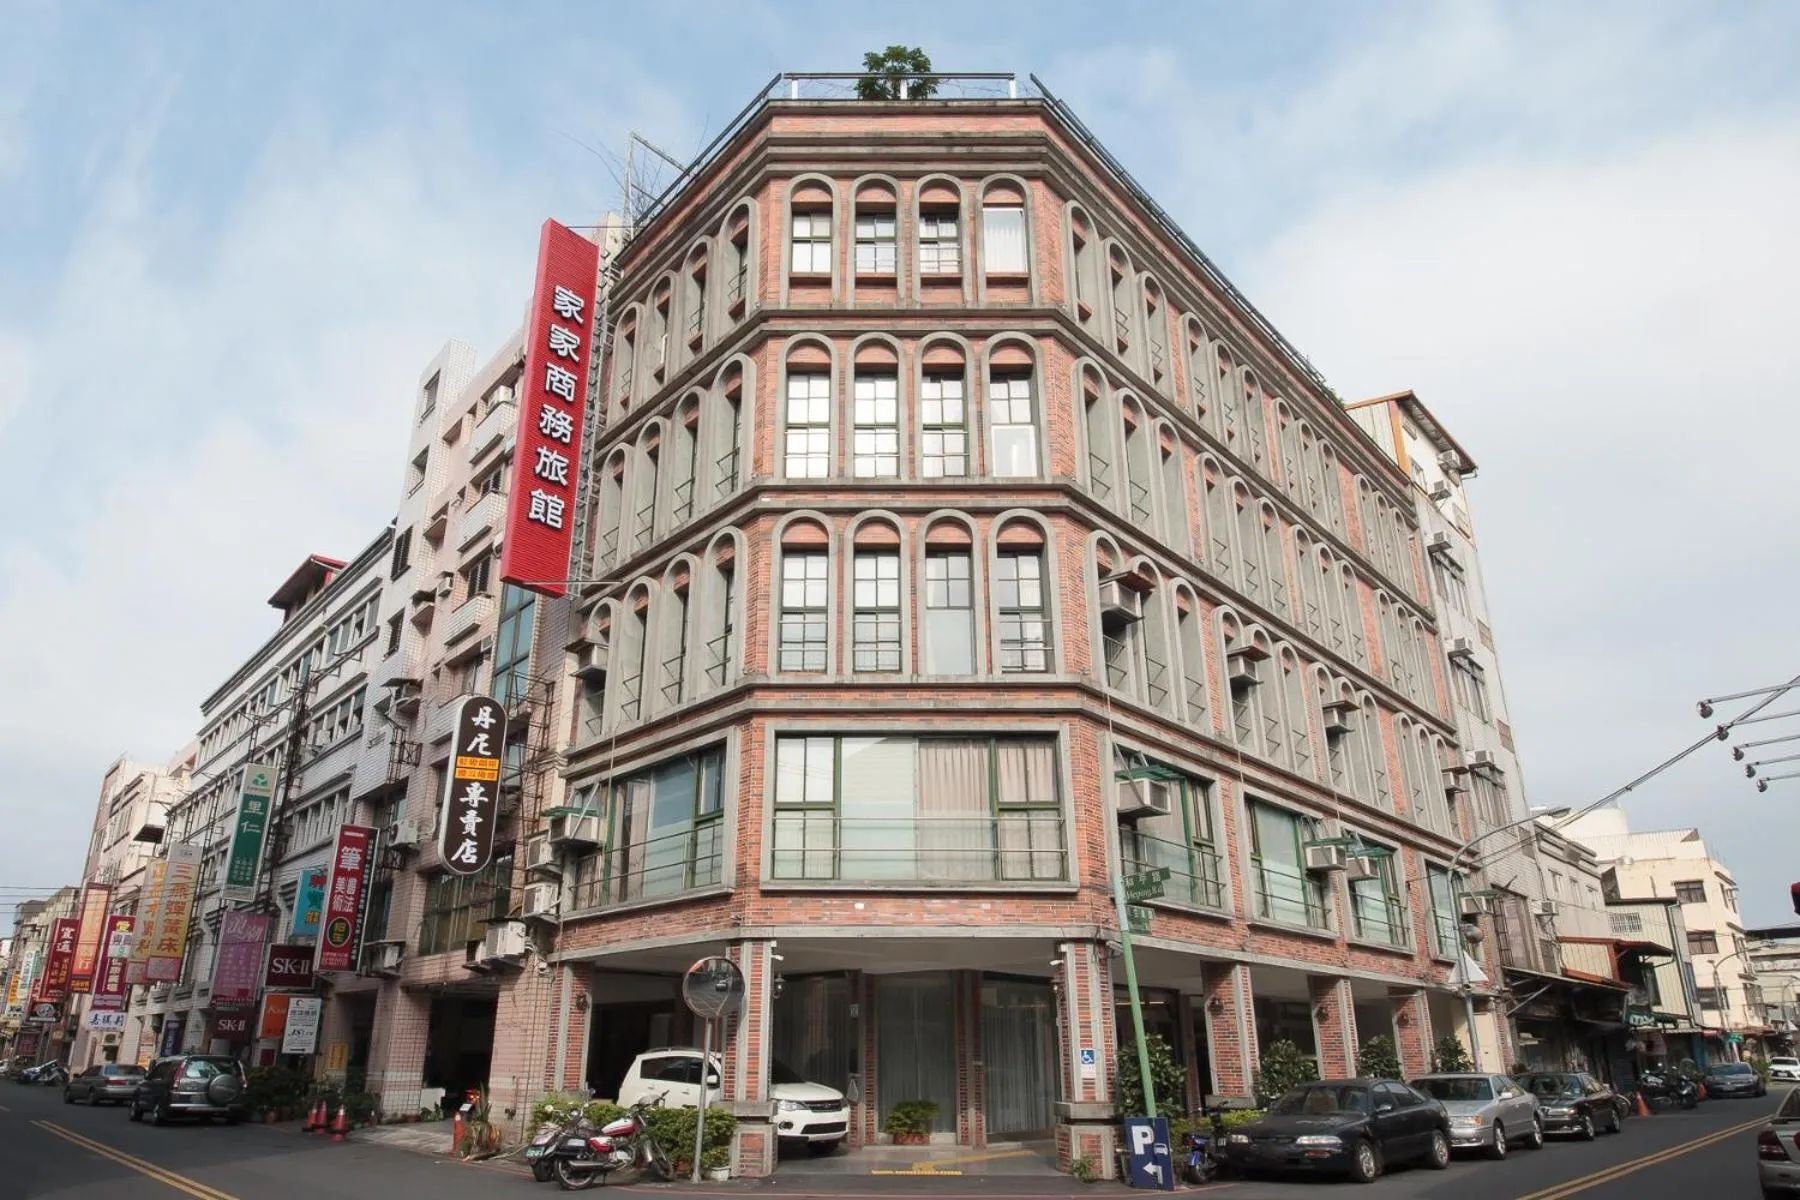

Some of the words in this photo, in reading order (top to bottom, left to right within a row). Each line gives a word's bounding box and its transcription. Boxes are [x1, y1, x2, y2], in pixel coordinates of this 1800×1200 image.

[529, 285, 585, 529] 家家商務旅館
[467, 706, 496, 756] 丹尼
[241, 801, 265, 834] 里仁
[451, 781, 489, 864] 專賣店
[271, 957, 310, 974] SK-II
[218, 1018, 246, 1031] SK-II
[1131, 1125, 1154, 1155] P
